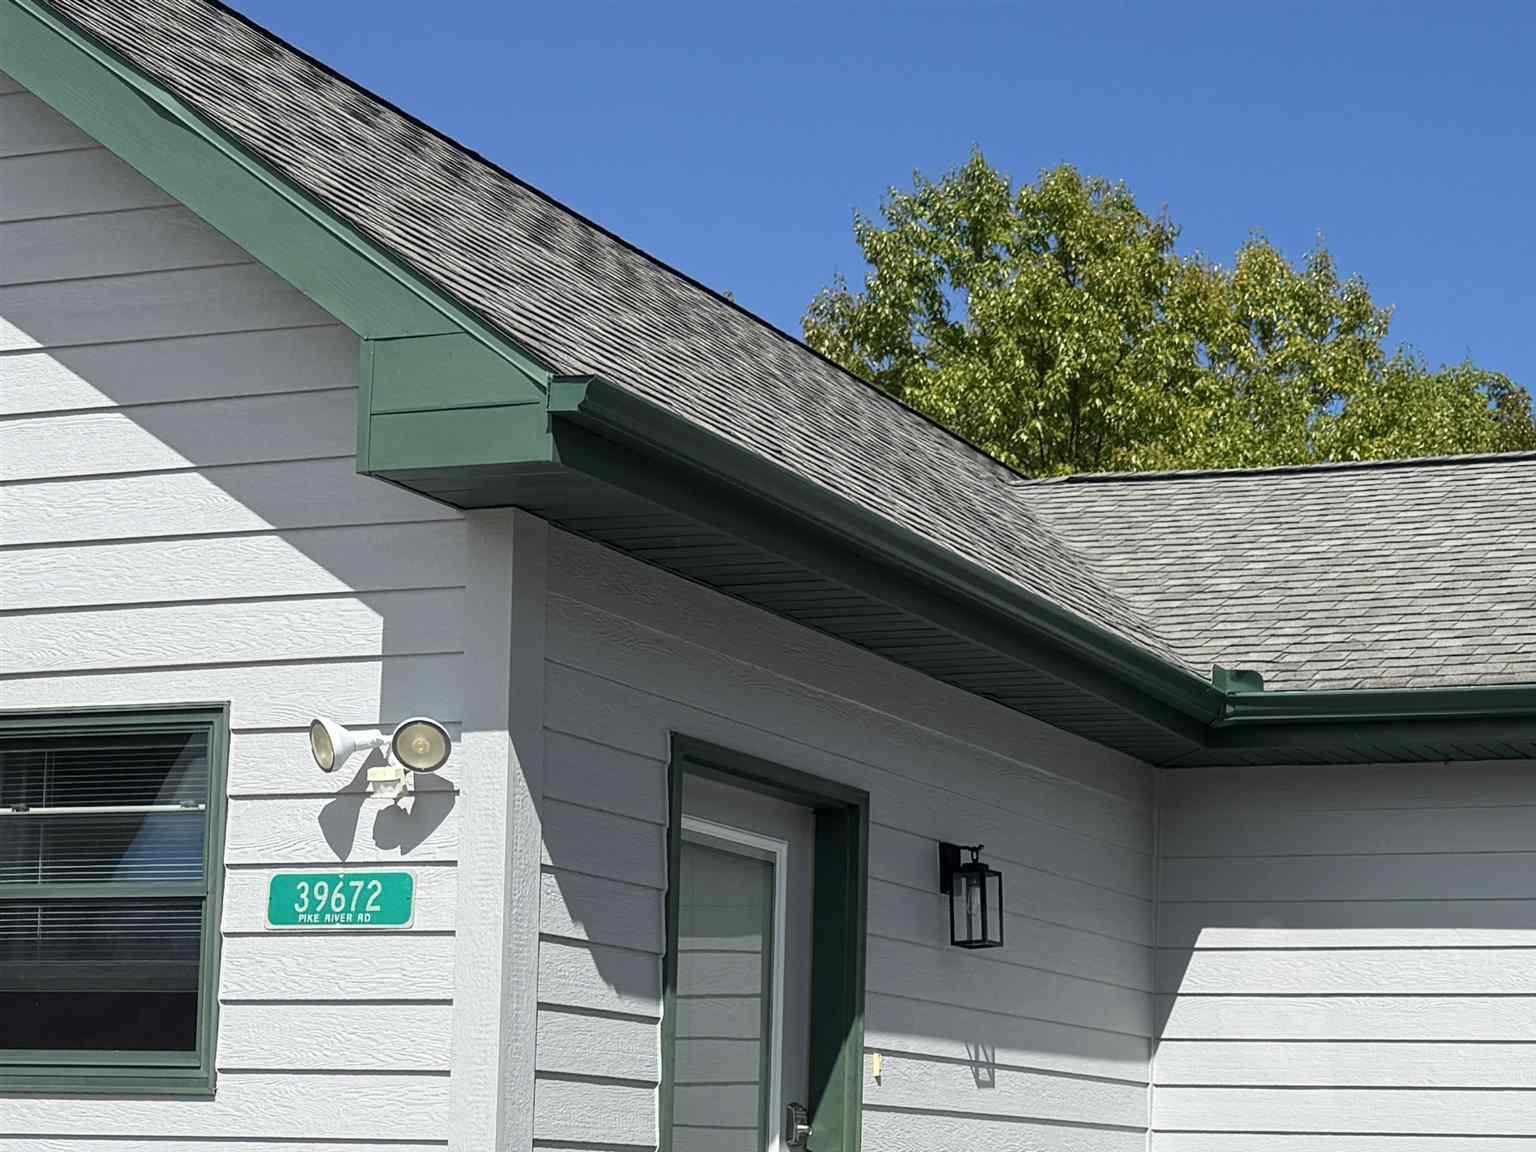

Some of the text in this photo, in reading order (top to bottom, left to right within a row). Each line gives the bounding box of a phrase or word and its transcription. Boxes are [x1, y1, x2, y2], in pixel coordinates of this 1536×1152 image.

[294, 880, 382, 913] 39672
[298, 912, 371, 923] PIKE RIVER RD
